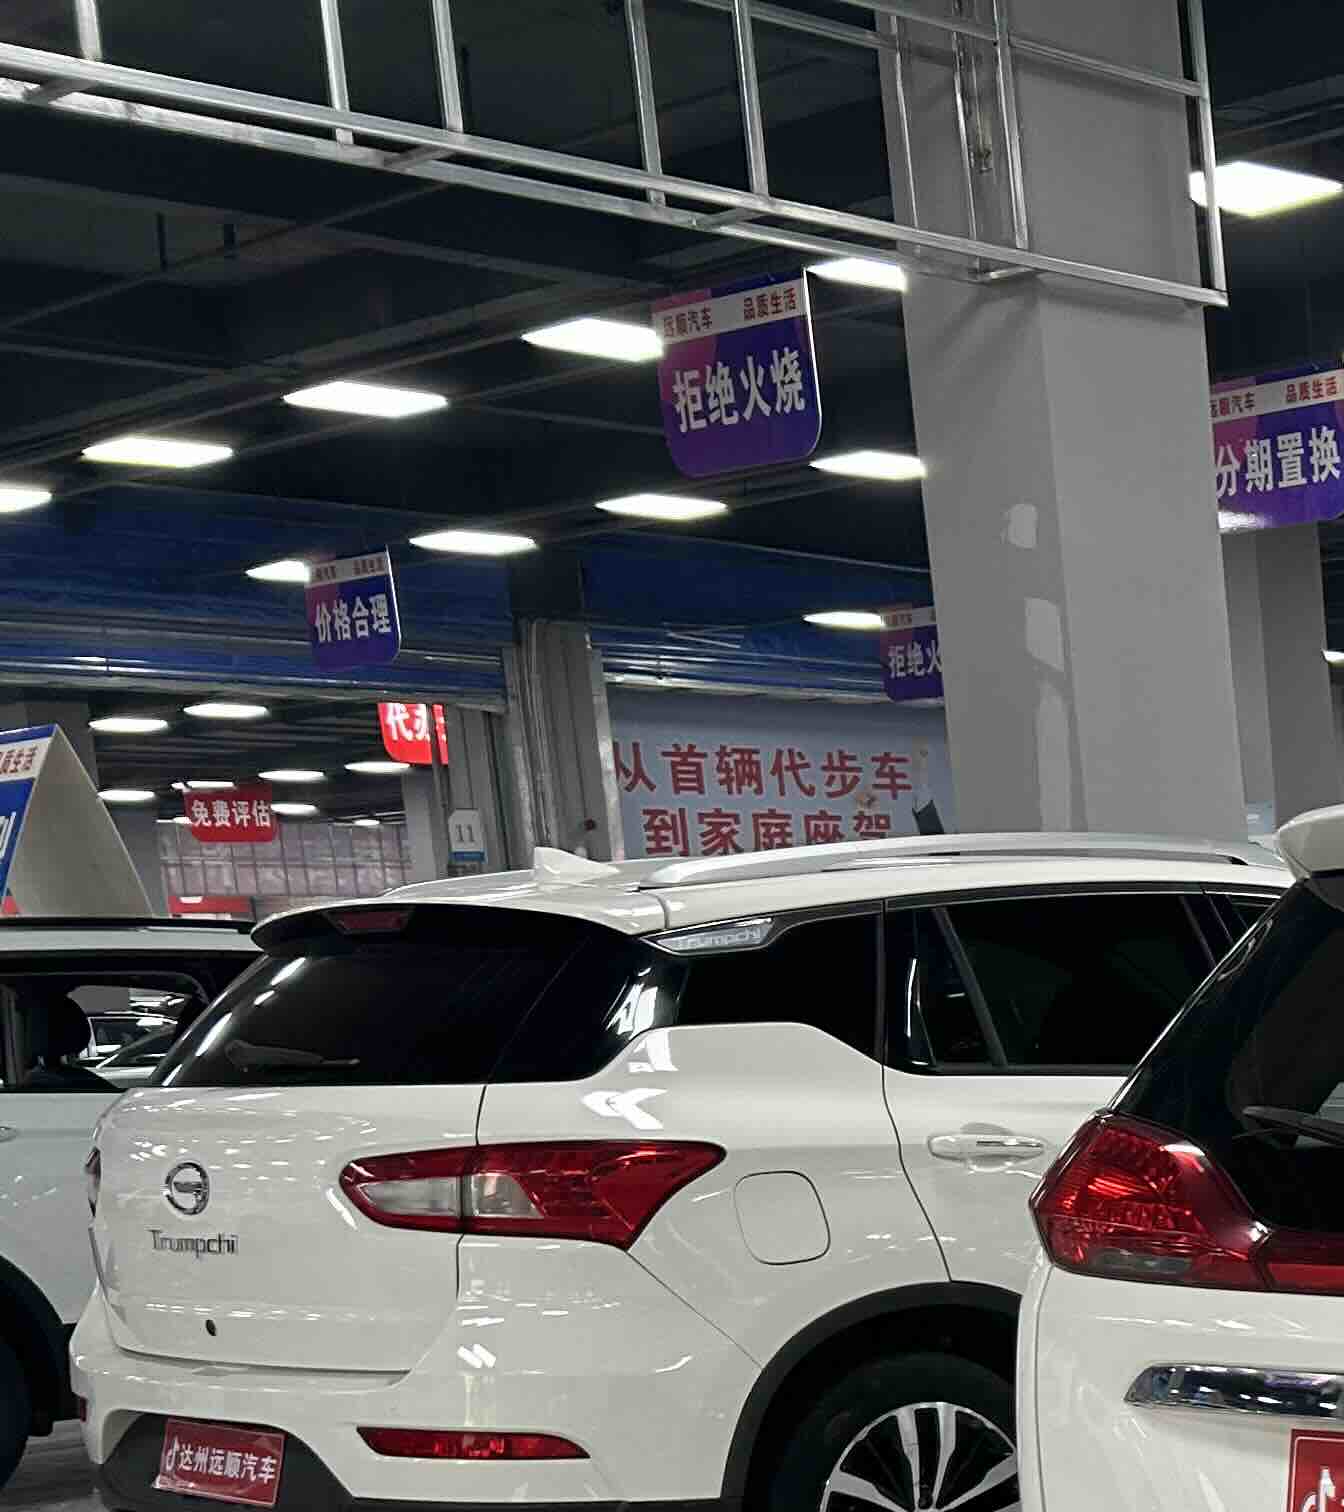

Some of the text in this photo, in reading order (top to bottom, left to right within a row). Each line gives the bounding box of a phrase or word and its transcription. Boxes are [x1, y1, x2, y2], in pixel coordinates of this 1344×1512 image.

[671, 346, 806, 433] 拒绝火烧
[1285, 375, 1338, 403] 品质生活
[1216, 426, 1342, 499] 分期置换
[315, 592, 392, 643] 价格合理
[612, 741, 913, 801] 从首辆代步车
[190, 799, 272, 828] 免费评估
[455, 824, 476, 843] 11
[147, 1228, 240, 1260] Trumpchi
[178, 1442, 277, 1484] 达州远顺汽车
